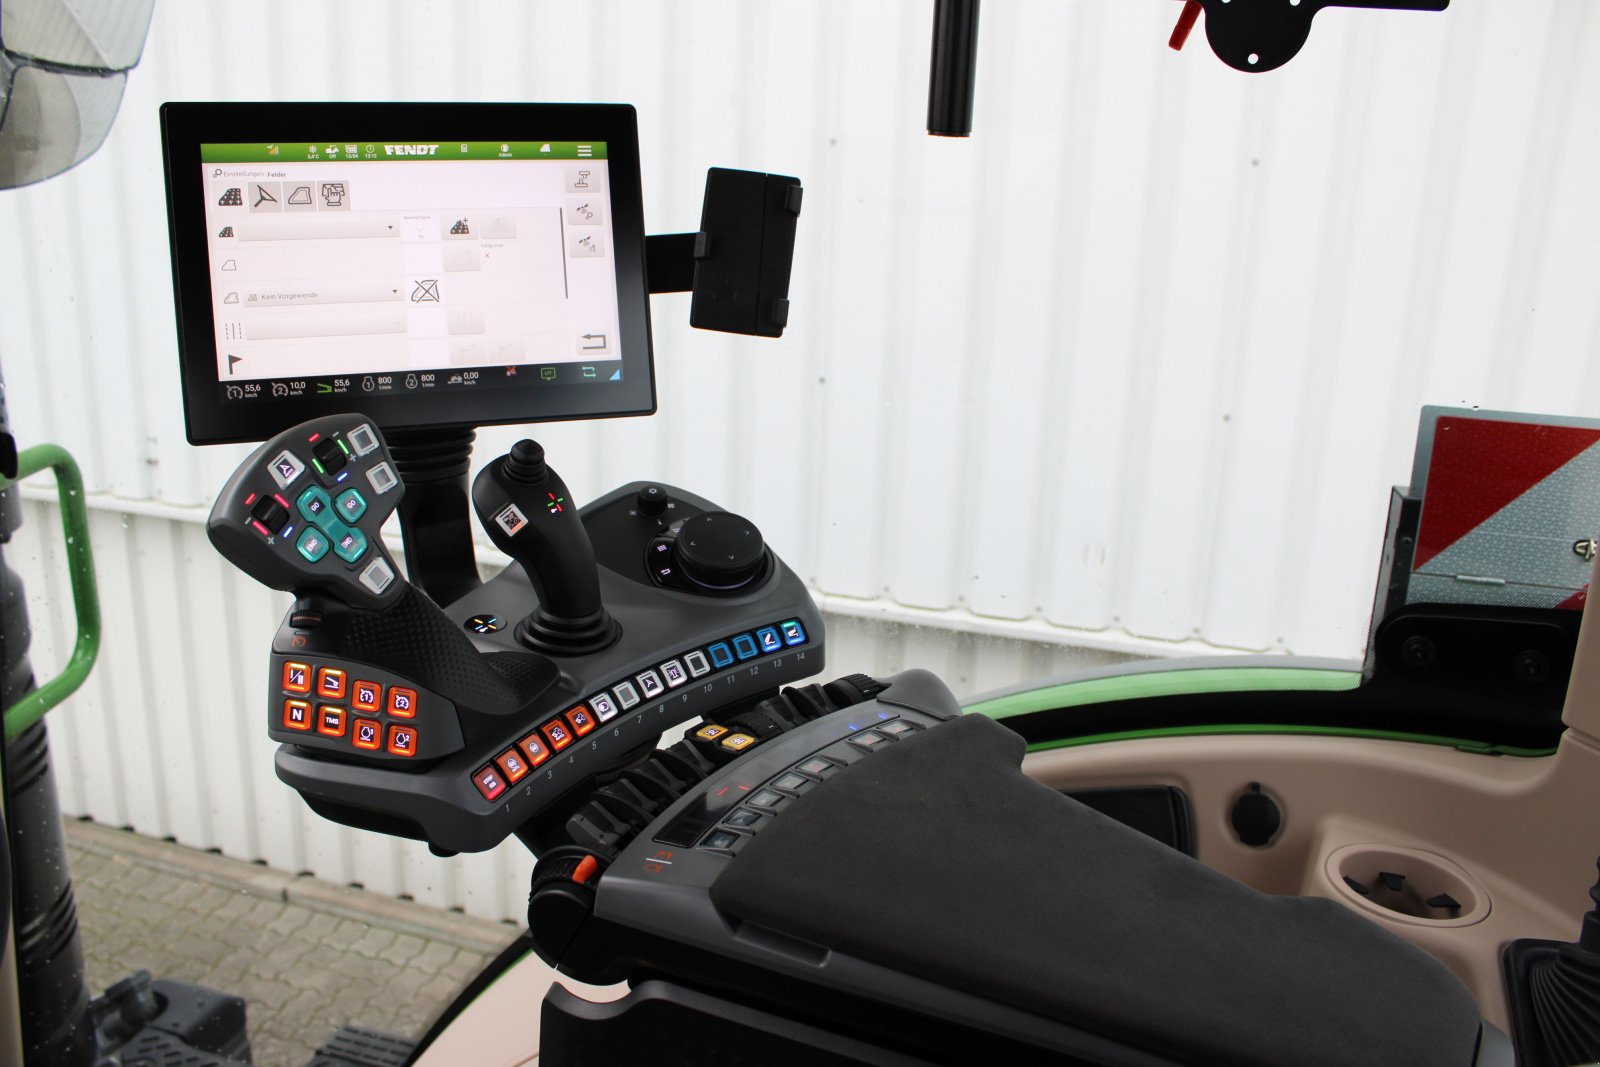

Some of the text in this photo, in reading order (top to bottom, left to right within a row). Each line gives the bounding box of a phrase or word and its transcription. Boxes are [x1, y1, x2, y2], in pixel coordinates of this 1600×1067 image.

[384, 144, 439, 156] FENDT
[261, 291, 319, 301] Kein Vorgewende
[377, 376, 392, 384] 800
[420, 374, 435, 382] 800
[463, 372, 479, 380] 0,00
[290, 381, 305, 390] 10,0
[334, 379, 350, 387] 55,6
[245, 384, 261, 392] 55,6
[310, 501, 320, 512] GO
[346, 499, 356, 509] GO
[796, 652, 805, 662] 14
[773, 659, 783, 668] 13
[749, 666, 760, 676] 12
[726, 674, 736, 684] 11
[703, 683, 713, 694] 10
[682, 694, 688, 703] 9
[659, 704, 665, 713] 8
[292, 708, 303, 721] N
[637, 714, 643, 724] 7
[325, 716, 339, 725] TMS
[614, 727, 619, 737] 6
[592, 741, 598, 750] 5
[569, 755, 575, 764] 4
[547, 770, 552, 779] 3
[526, 787, 531, 796] 2
